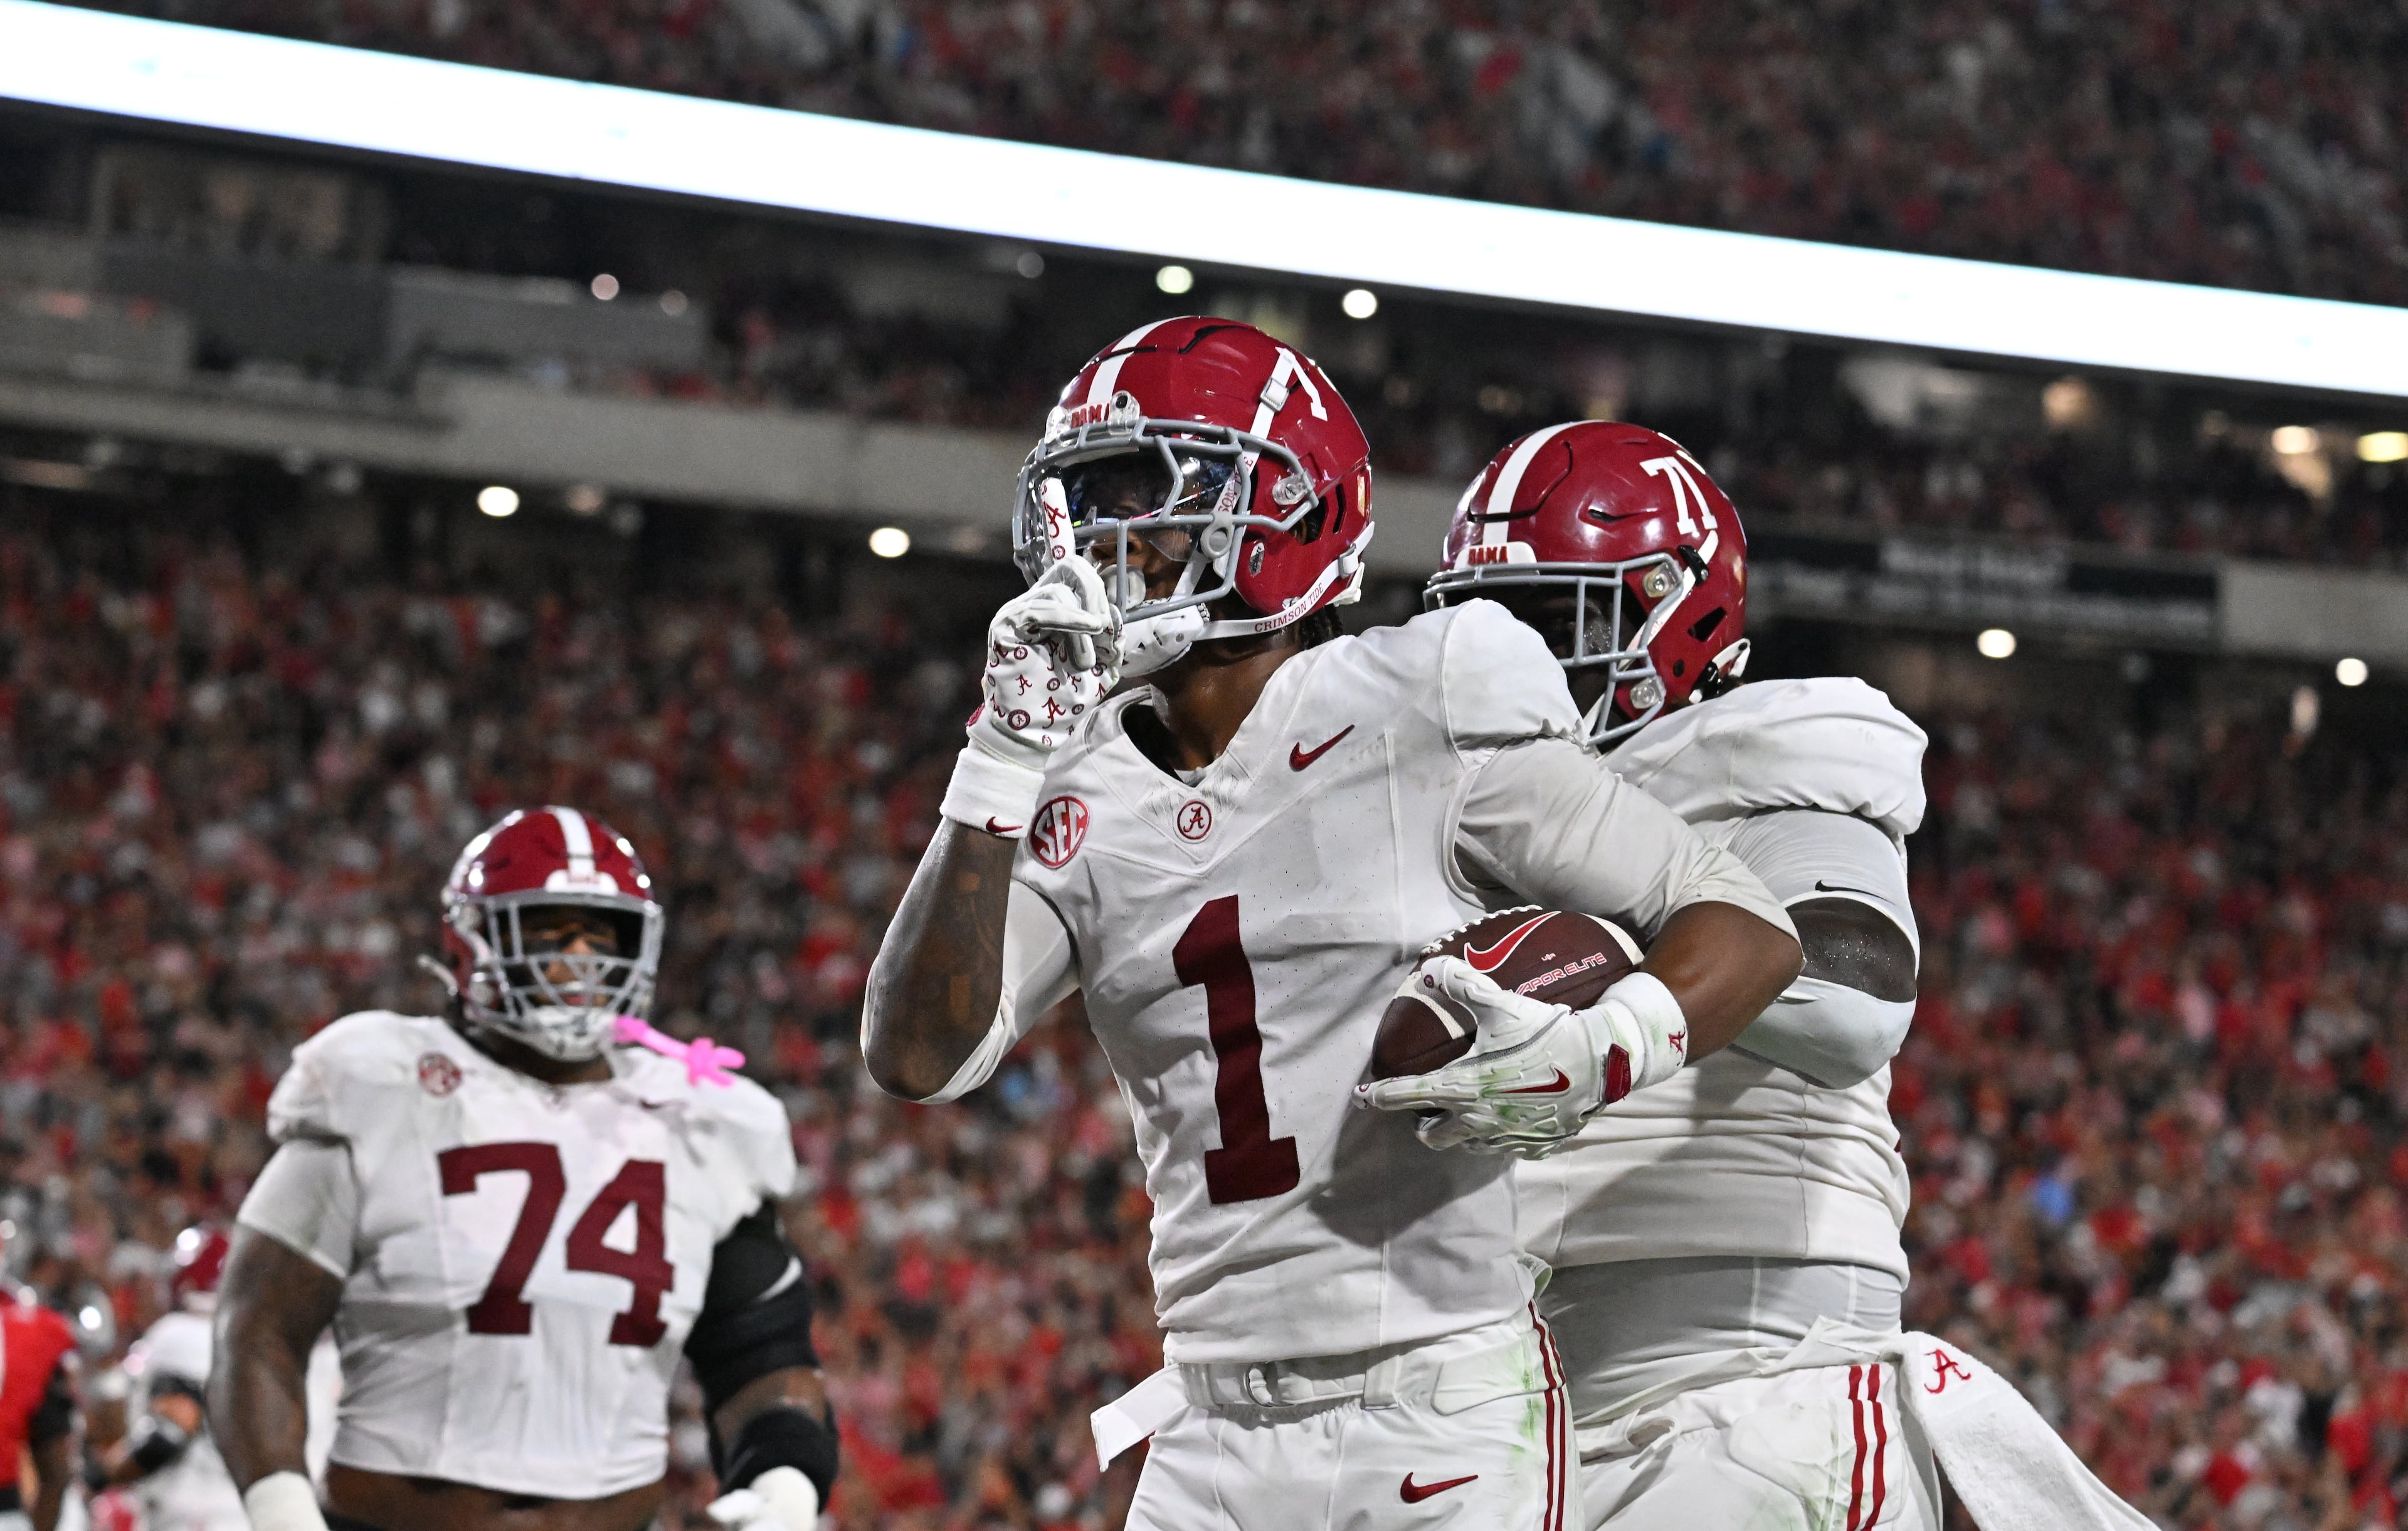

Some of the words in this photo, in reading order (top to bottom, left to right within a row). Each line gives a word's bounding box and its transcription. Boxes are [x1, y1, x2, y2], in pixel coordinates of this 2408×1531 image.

[1639, 456, 1718, 535] 71
[1468, 546, 1508, 566] BAMA
[1255, 600, 1307, 633] CRIMSON
[1309, 582, 1324, 605] TIDE
[1035, 800, 1085, 862] SEC
[1183, 806, 1205, 833] A
[1564, 952, 1607, 976] ELITE
[1173, 894, 1300, 1204] 1
[437, 1141, 674, 1348] 74
[1924, 1348, 1971, 1394] A
